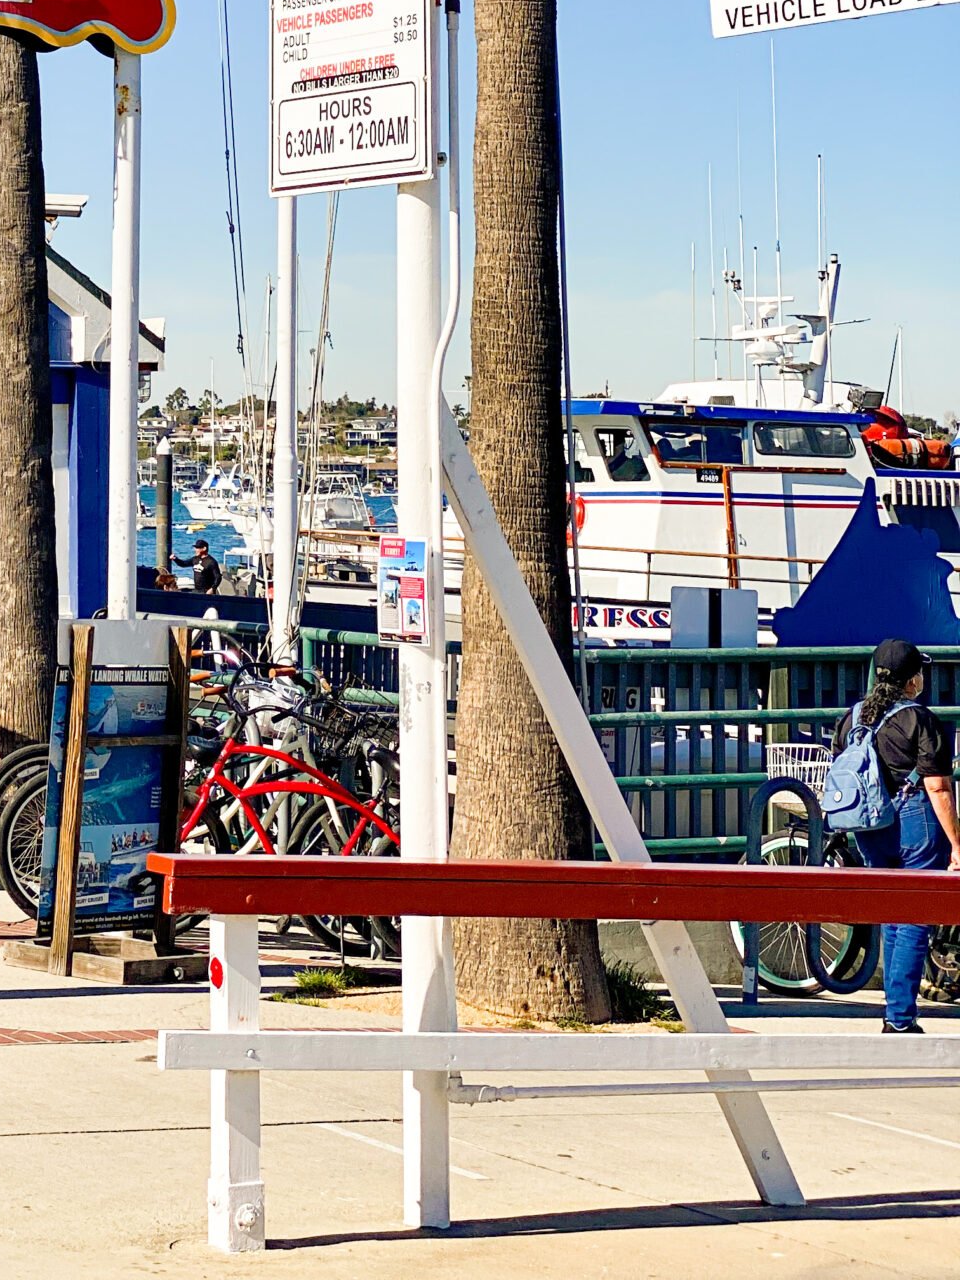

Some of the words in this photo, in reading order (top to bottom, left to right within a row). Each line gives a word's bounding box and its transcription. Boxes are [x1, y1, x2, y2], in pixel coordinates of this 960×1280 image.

[276, 14, 312, 33] VEHICLE
[314, 2, 374, 26] PASSENGERS
[283, 32, 310, 48] ADULT
[393, 14, 418, 28] $1.25
[283, 48, 308, 64] CHILD
[393, 29, 418, 44] $0.50
[294, 82, 304, 94] NO
[306, 78, 328, 92] BILLS
[328, 74, 361, 88] LARGER
[362, 70, 384, 83] THAN
[384, 67, 398, 80] $20
[300, 62, 338, 81] CHILDREN
[340, 58, 366, 74] UNDER
[368, 58, 372, 68] 5
[374, 53, 395, 68] FREE
[320, 96, 372, 122] HOURS
[286, 125, 334, 158] 6:30AM
[348, 116, 408, 150] 12:00AM
[573, 606, 669, 628] RESS
[94, 670, 124, 682] LANDING
[125, 670, 148, 682] WHALE
[148, 670, 168, 682] WATC
